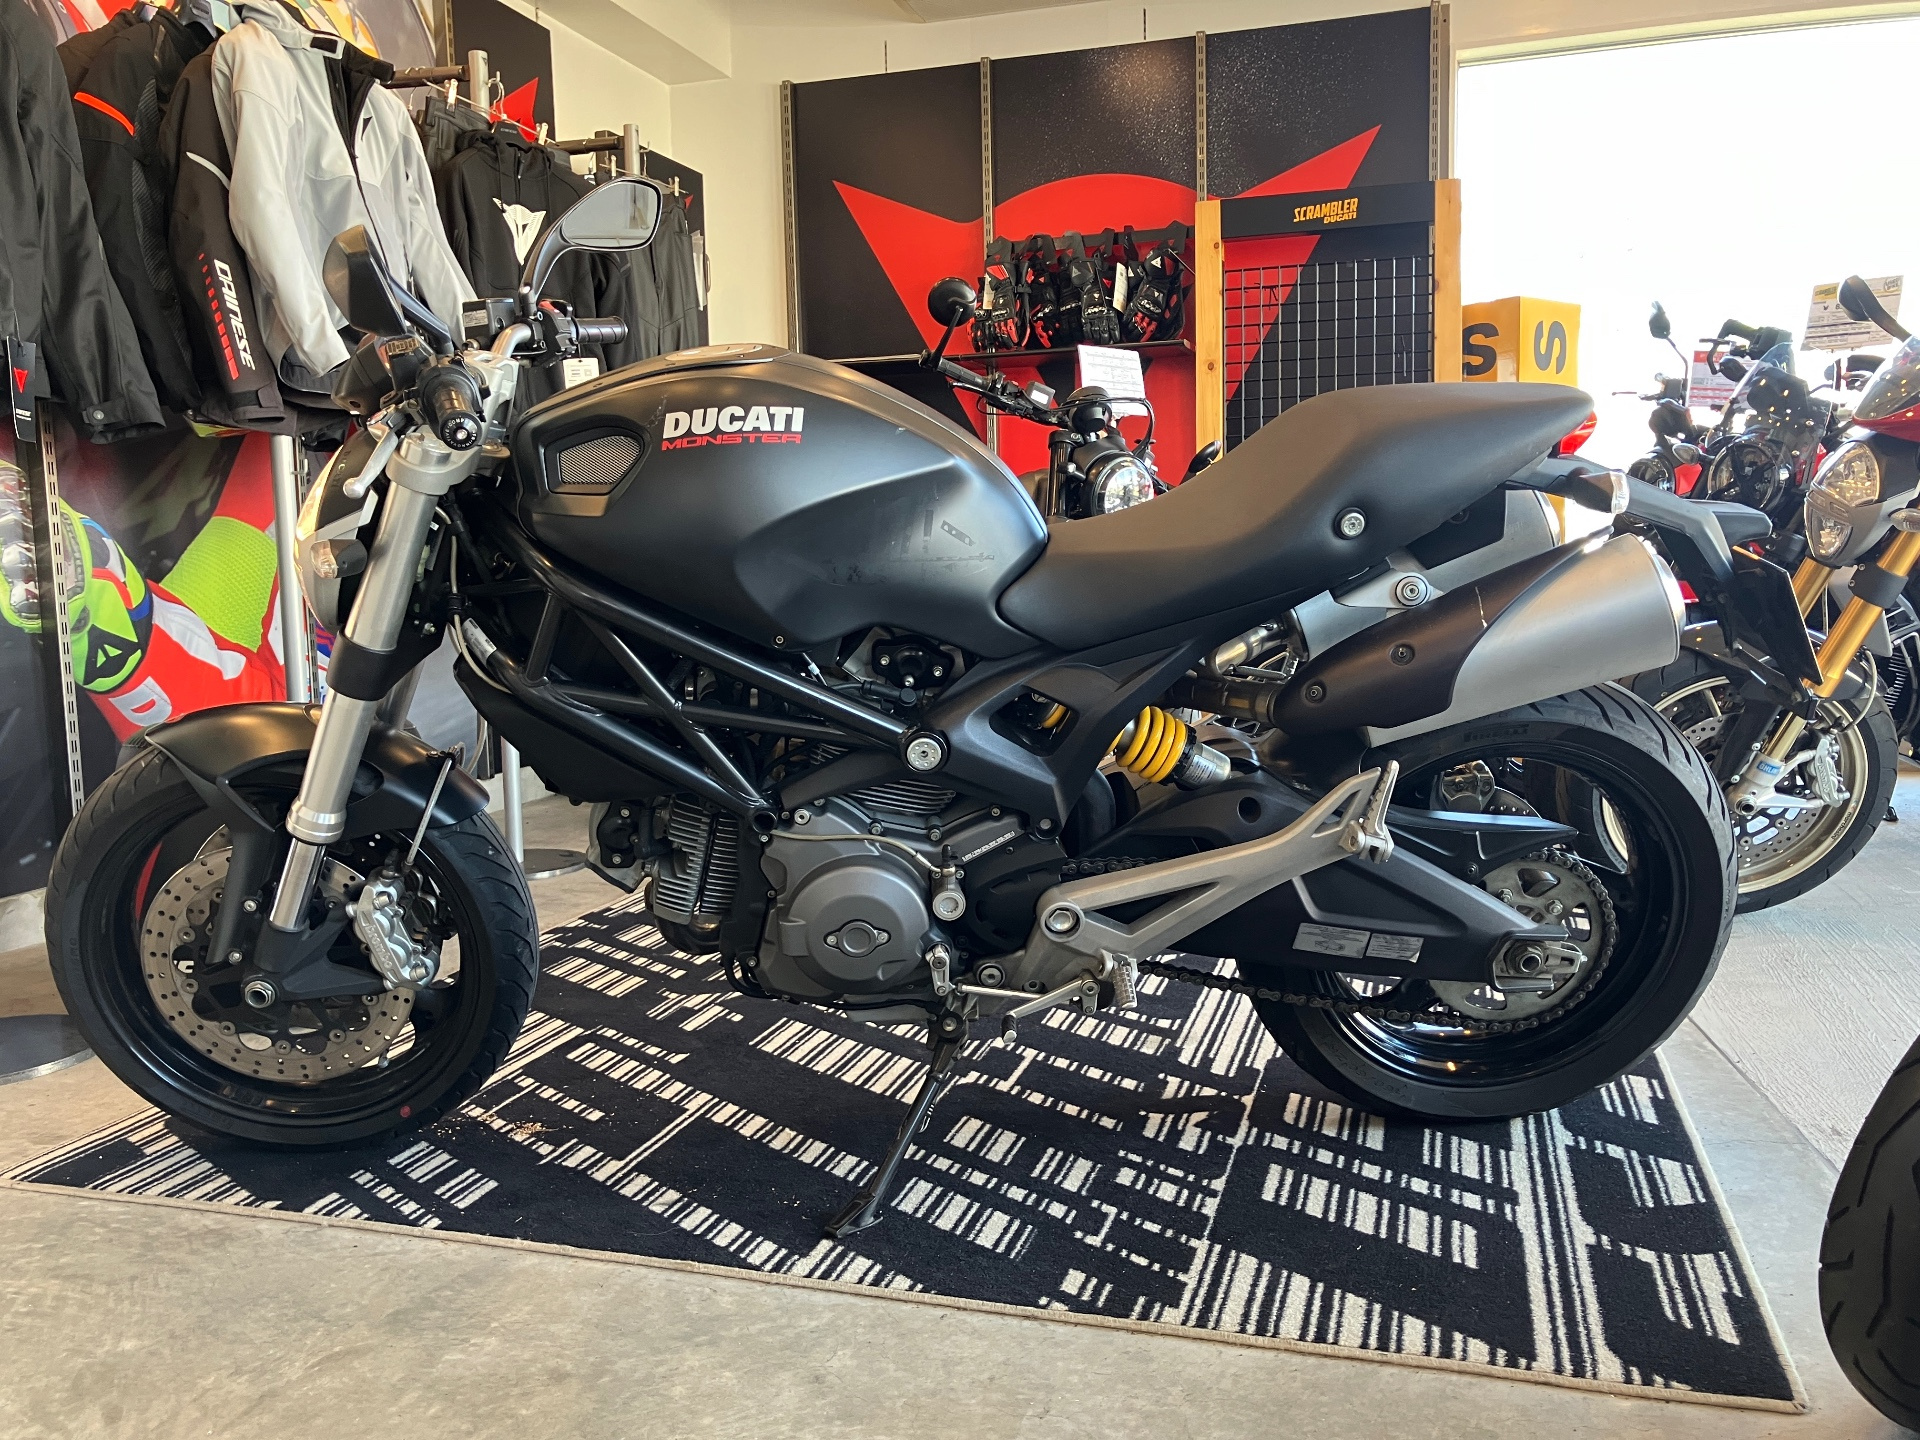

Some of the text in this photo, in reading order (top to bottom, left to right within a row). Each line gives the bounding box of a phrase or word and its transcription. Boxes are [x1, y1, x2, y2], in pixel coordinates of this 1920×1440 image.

[1293, 197, 1358, 222] SCRAMBLER
[1323, 211, 1357, 224] DUCATI
[213, 258, 256, 371] DAINESE
[1462, 322, 1500, 376] S
[1533, 320, 1567, 375] S
[662, 405, 805, 439] DUCATI
[661, 433, 803, 451] MONSTER
